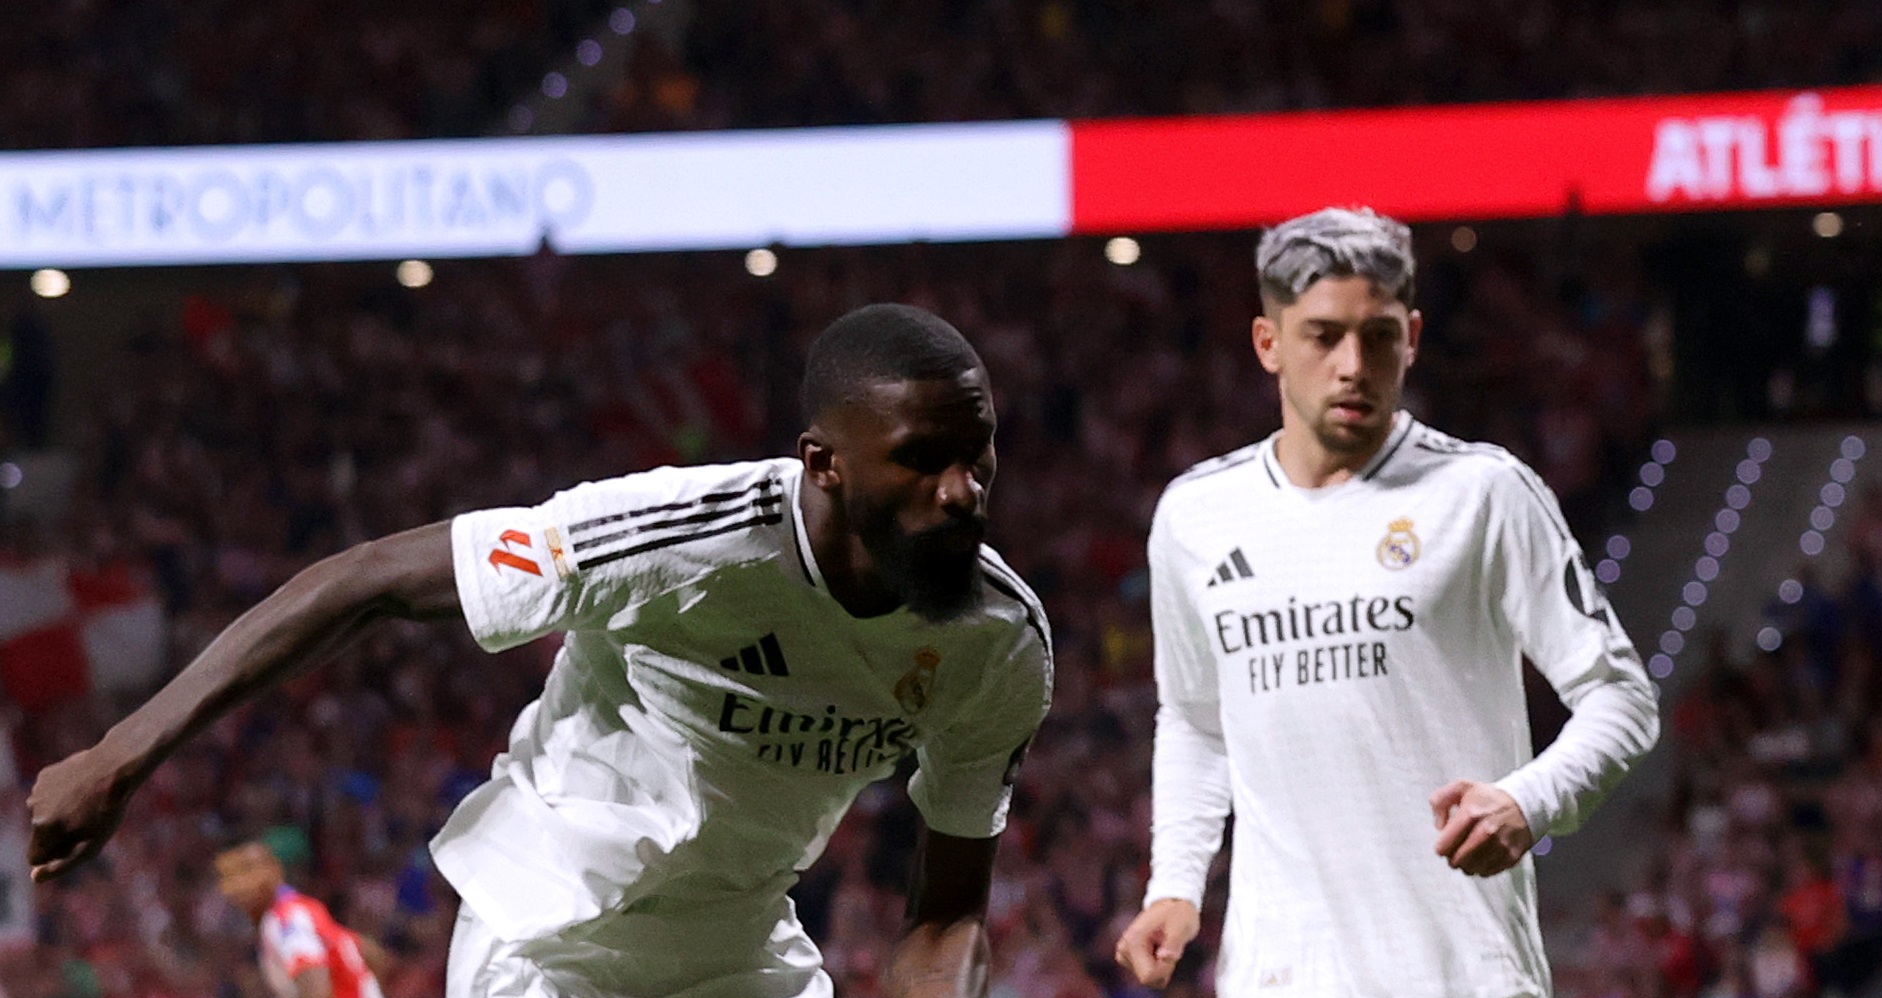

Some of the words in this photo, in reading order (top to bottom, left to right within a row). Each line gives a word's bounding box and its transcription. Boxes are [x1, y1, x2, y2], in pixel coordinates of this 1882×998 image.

[12, 158, 597, 244] METROPOLITANO
[1215, 593, 1414, 654] Emirates
[1249, 653, 1284, 694] FLY
[1297, 642, 1388, 685] BETTER
